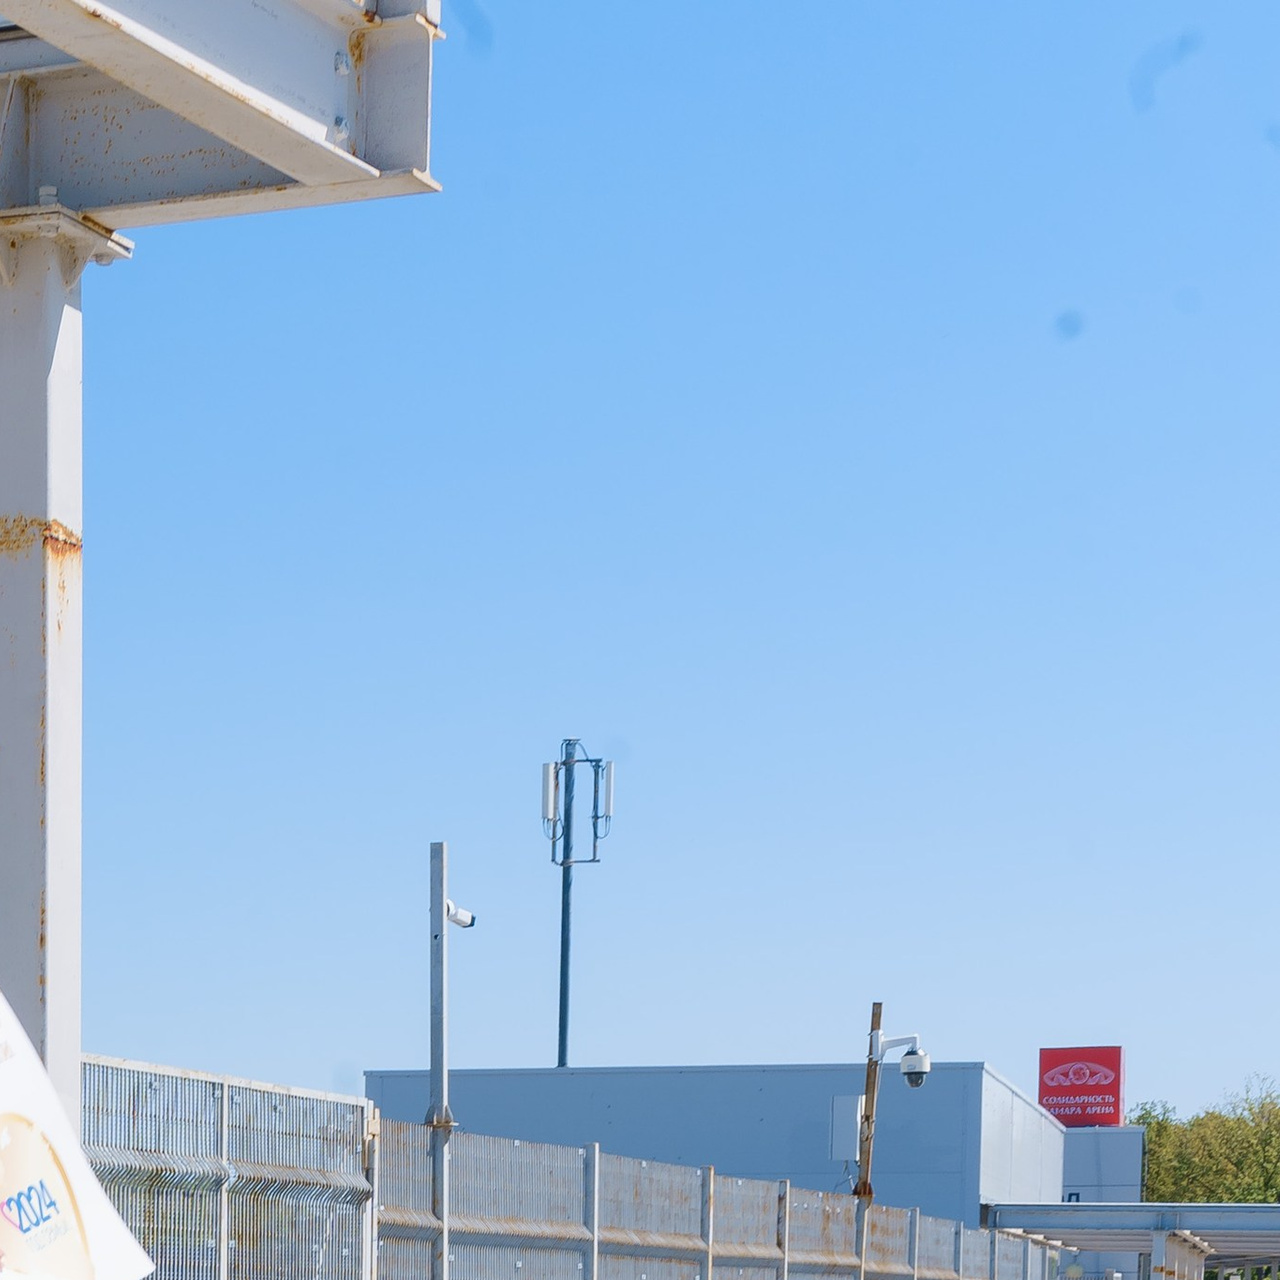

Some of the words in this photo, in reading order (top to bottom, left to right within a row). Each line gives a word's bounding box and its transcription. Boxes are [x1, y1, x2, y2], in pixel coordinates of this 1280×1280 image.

[1042, 1095, 1115, 1104] СОЛИДАРНОСТЬ
[1049, 1106, 1082, 1115] АМАРА
[1084, 1105, 1115, 1115] АРЕНА
[6, 1179, 60, 1233] 2024
